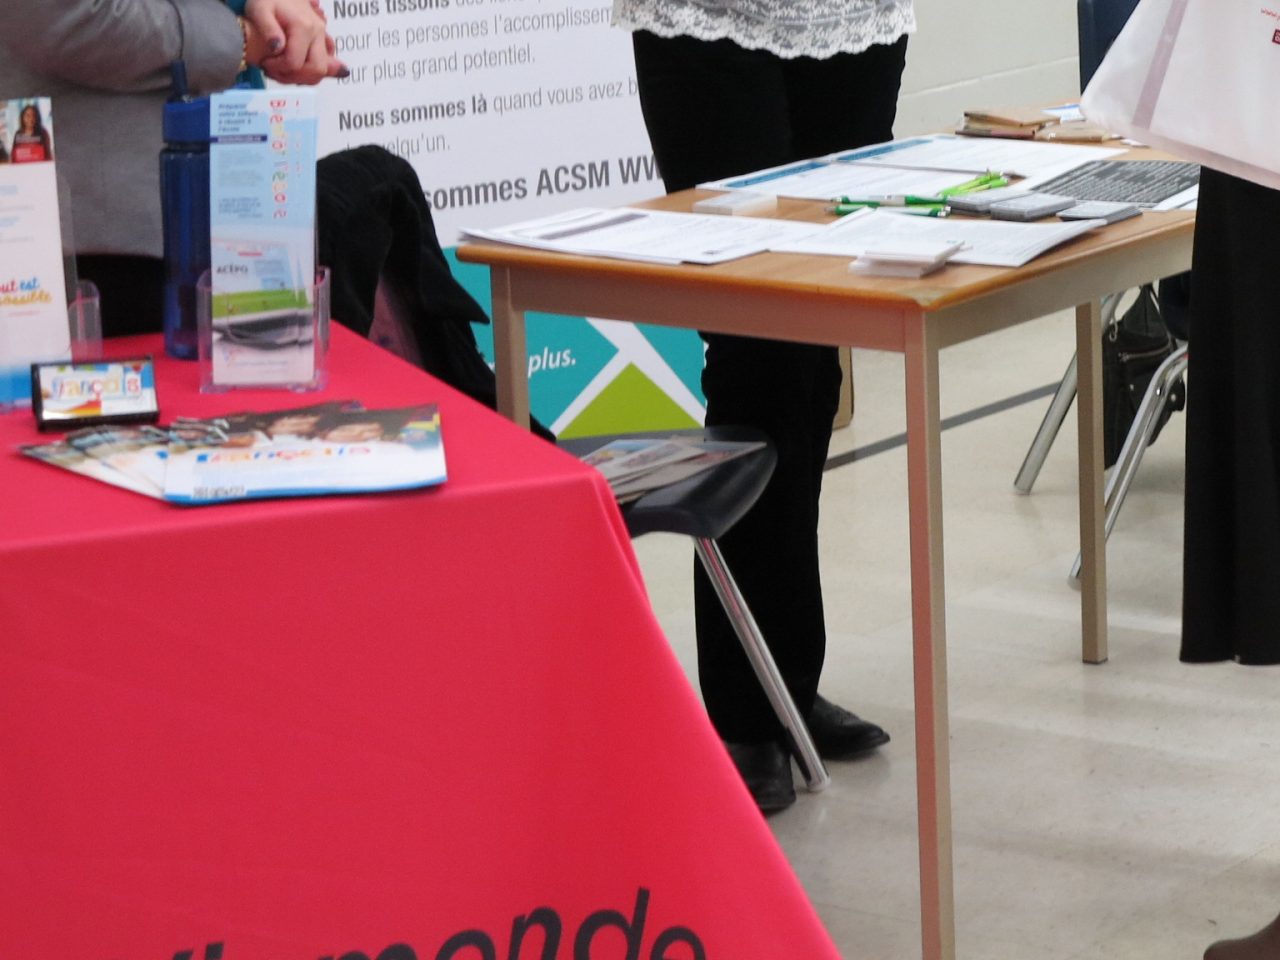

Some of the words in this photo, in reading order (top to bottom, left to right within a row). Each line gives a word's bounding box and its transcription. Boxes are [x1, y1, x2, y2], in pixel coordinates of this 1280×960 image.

[335, 31, 371, 54] pour
[378, 27, 401, 49] les
[405, 18, 488, 48] personnes
[374, 60, 406, 85] plus
[412, 51, 458, 80] grand
[463, 43, 535, 72] potentiel.
[339, 110, 385, 131] Nous
[391, 100, 466, 125] sommes
[472, 93, 487, 114] là
[493, 88, 542, 115] quand
[547, 85, 583, 106] vous
[589, 80, 624, 100] avez
[536, 160, 610, 196] ACSM
[528, 346, 577, 378] plus.
